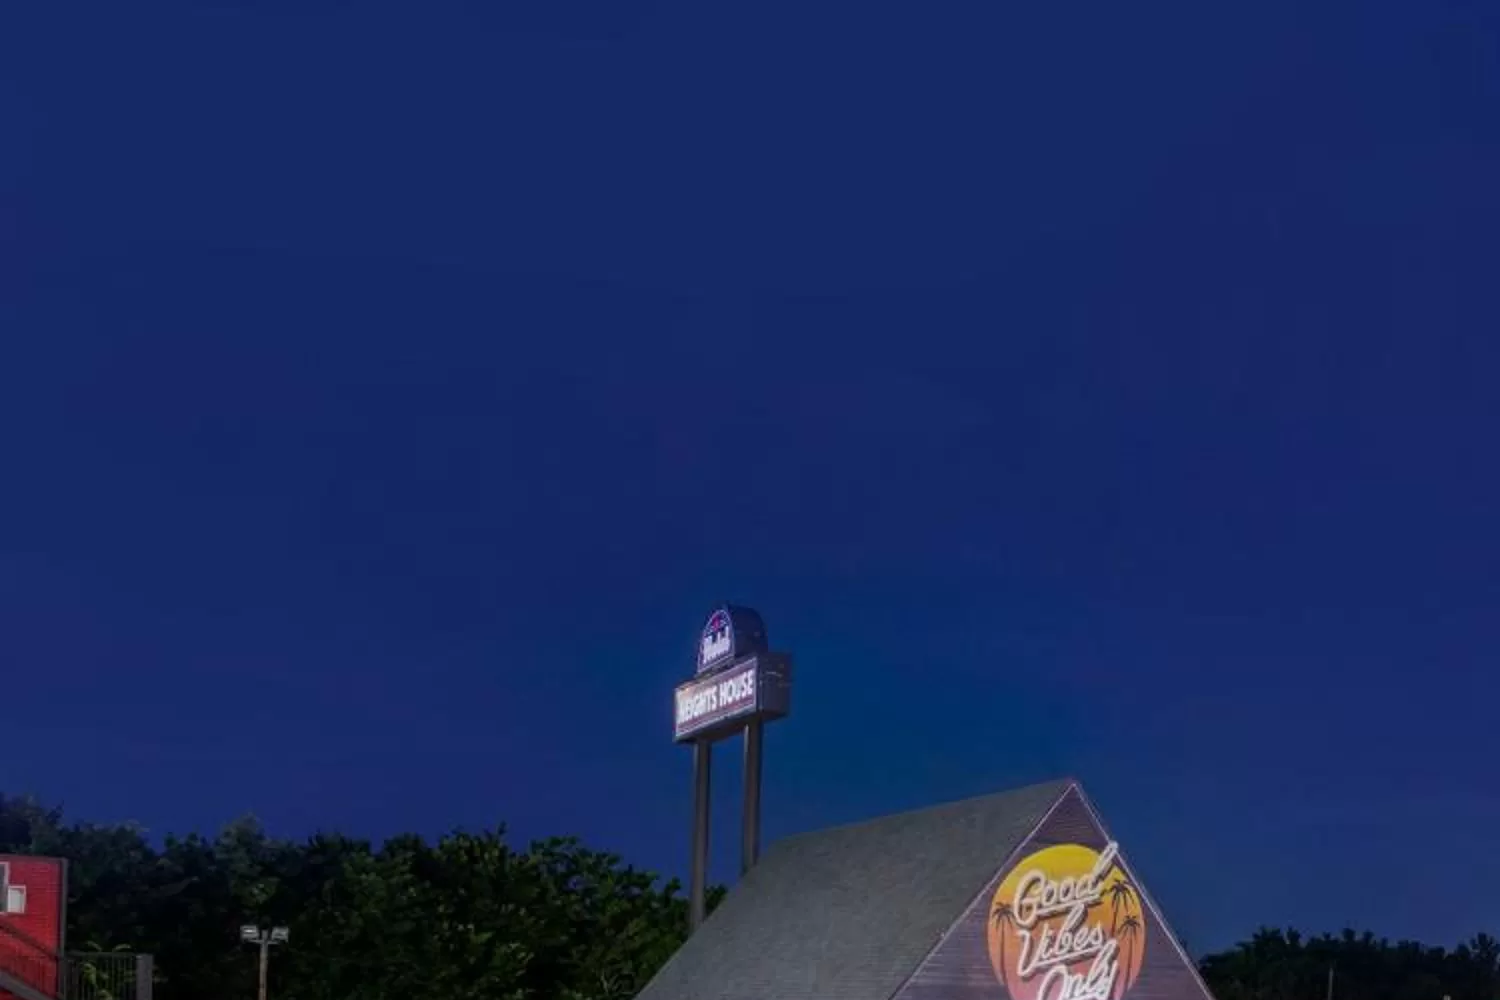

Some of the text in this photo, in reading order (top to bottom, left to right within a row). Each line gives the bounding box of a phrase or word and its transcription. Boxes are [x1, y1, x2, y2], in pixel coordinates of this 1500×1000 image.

[720, 670, 754, 707] HOUSE
[1013, 841, 1118, 925] Good
[1017, 903, 1104, 976] Vibes
